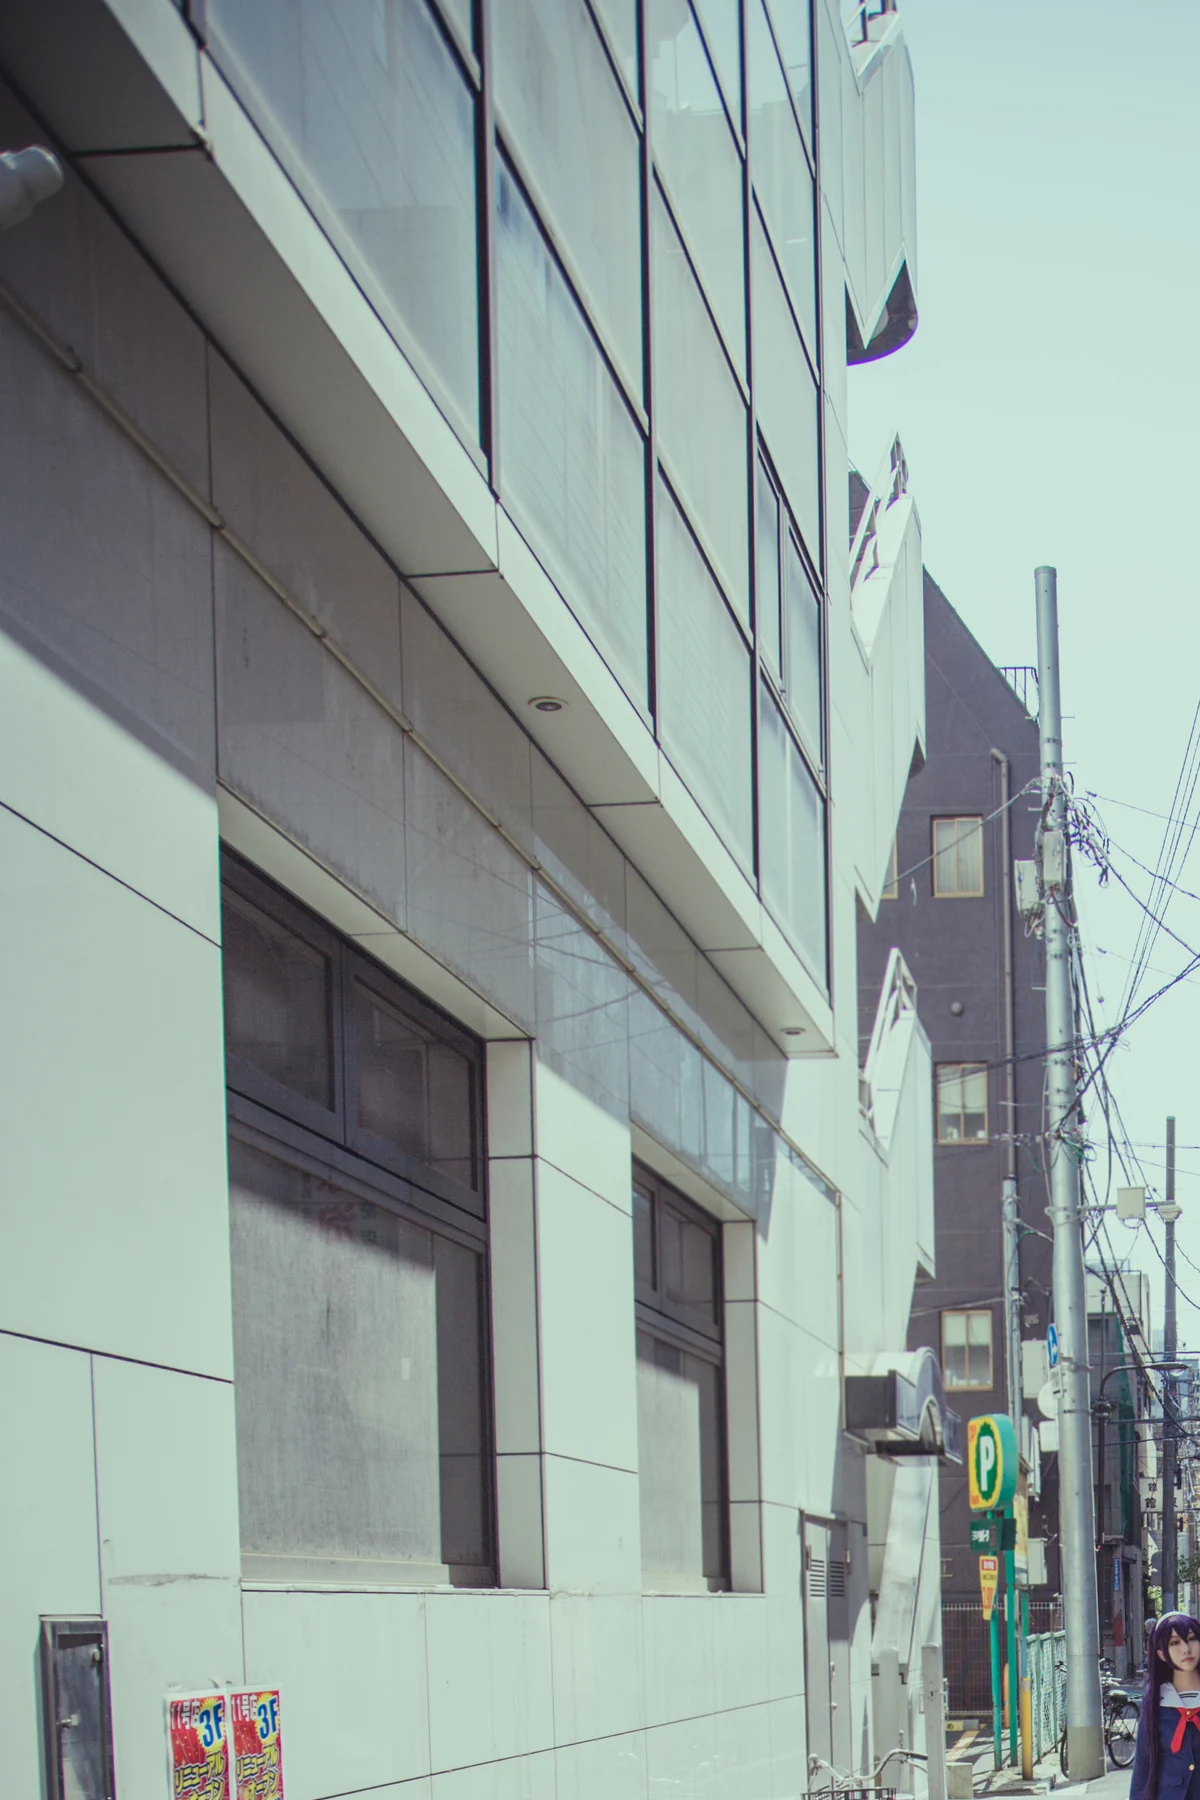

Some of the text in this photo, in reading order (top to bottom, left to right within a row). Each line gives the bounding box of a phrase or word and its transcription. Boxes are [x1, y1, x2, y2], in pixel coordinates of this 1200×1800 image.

[979, 1434, 996, 1492] P
[198, 1701, 225, 1748] 3F
[257, 1697, 279, 1740] 3F
[174, 1750, 226, 1797] リニューアル
[236, 1743, 279, 1785] リニューアル
